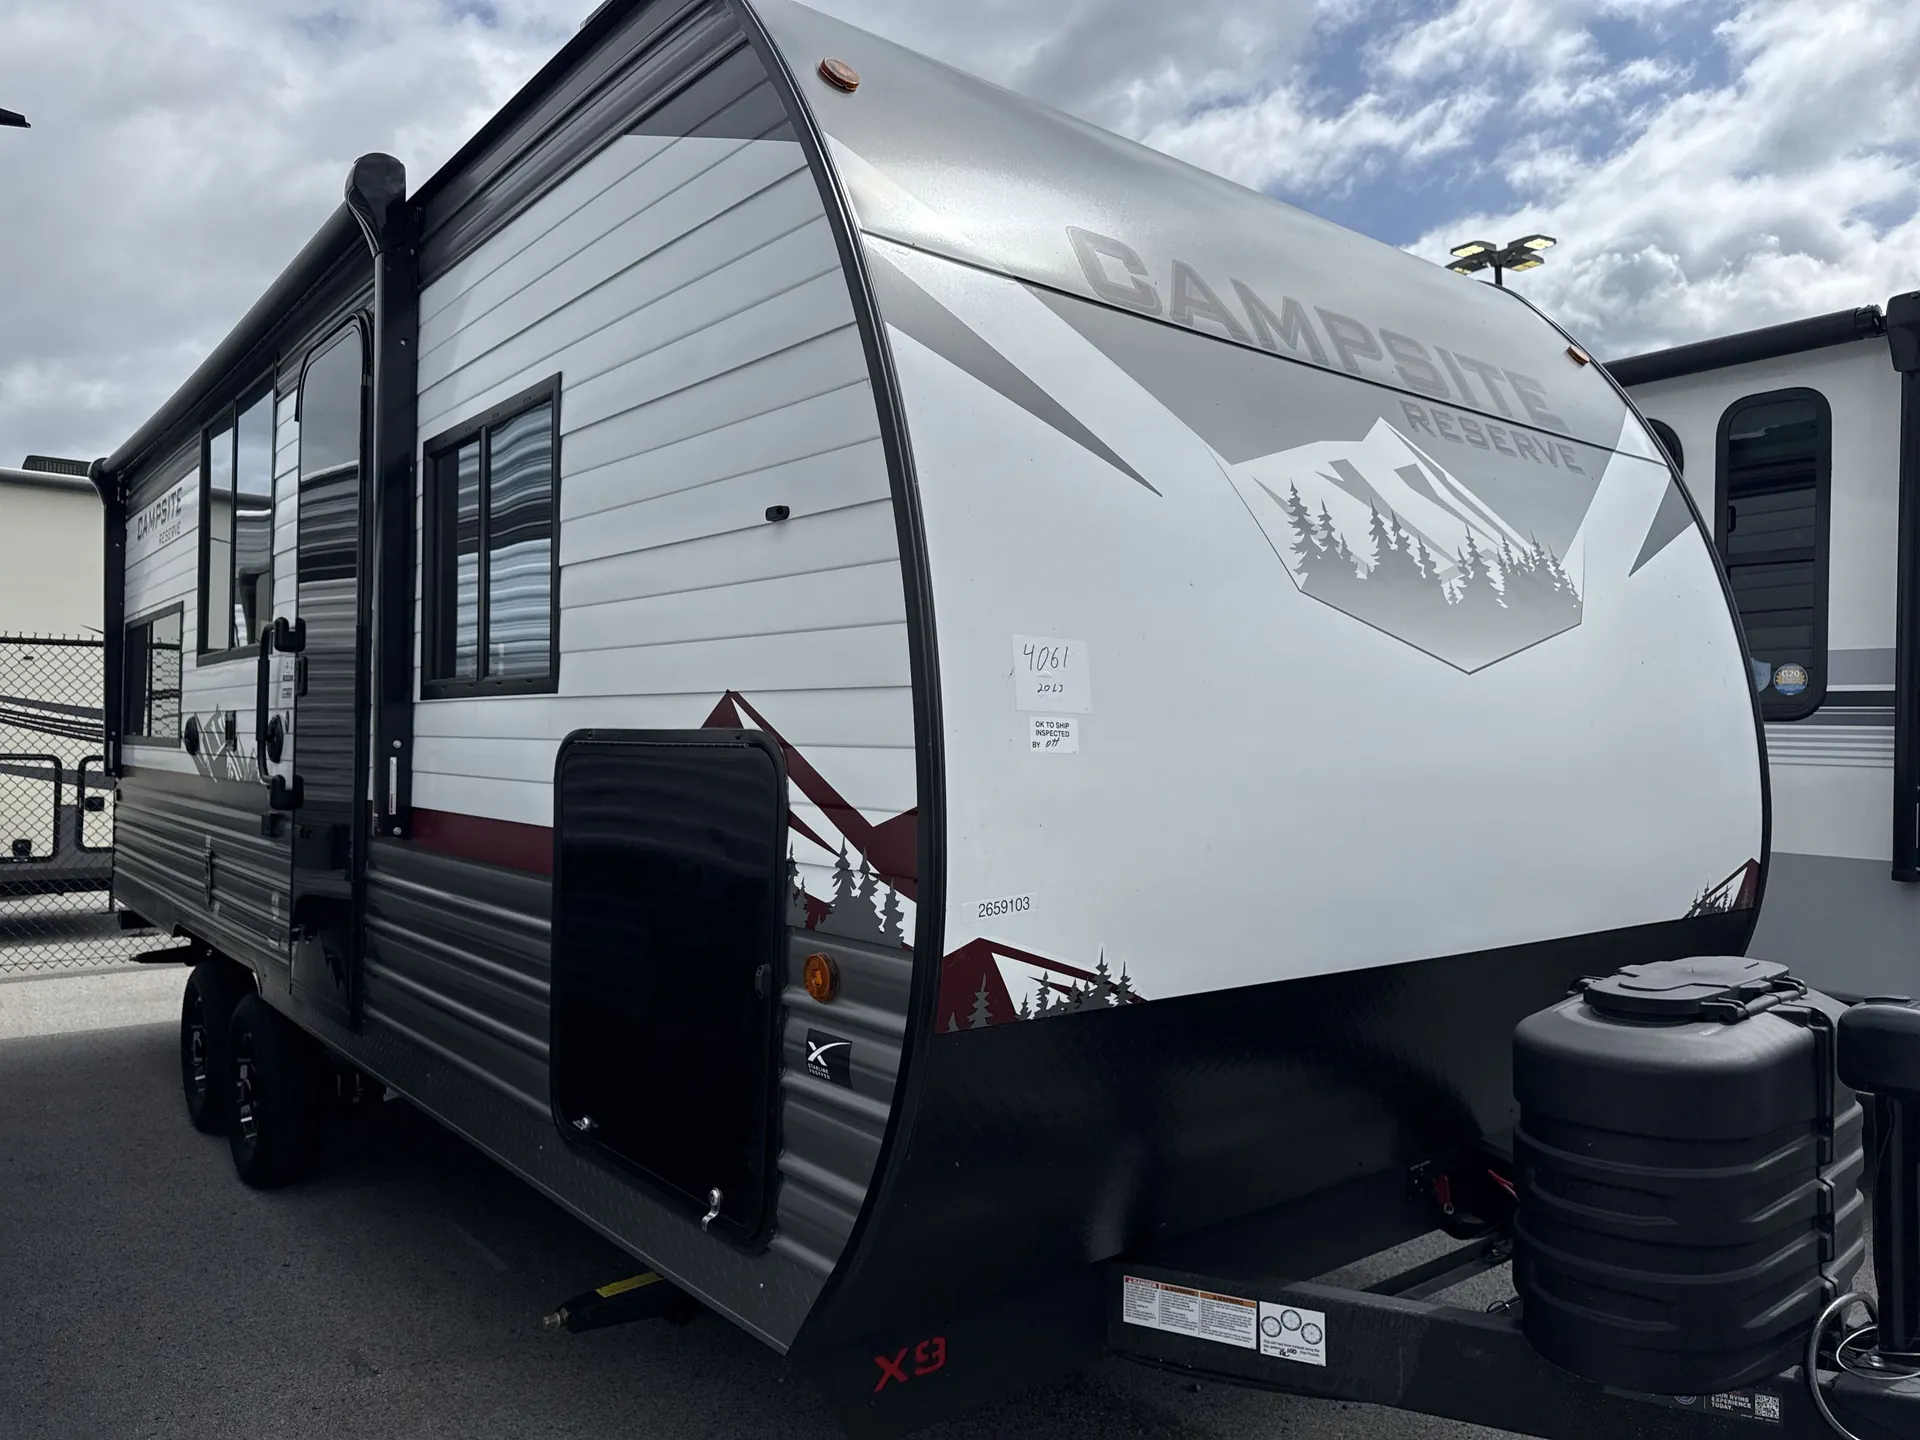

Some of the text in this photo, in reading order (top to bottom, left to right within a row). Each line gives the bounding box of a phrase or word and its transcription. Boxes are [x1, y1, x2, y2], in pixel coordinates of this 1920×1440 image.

[1066, 225, 1571, 435] CAMPSITE
[1400, 400, 1586, 476] RESERVE
[137, 487, 183, 541] CAMPSITE
[159, 521, 182, 544] RESERVE
[1023, 643, 1069, 671] 4061
[1035, 720, 1045, 728] OK
[1046, 721, 1055, 729] TO
[1035, 729, 1070, 738] INSPECTED
[978, 896, 1030, 918] 2659103
[1711, 1396, 1752, 1409] EXPERIENCE
[1711, 1401, 1734, 1411] TODAY.
